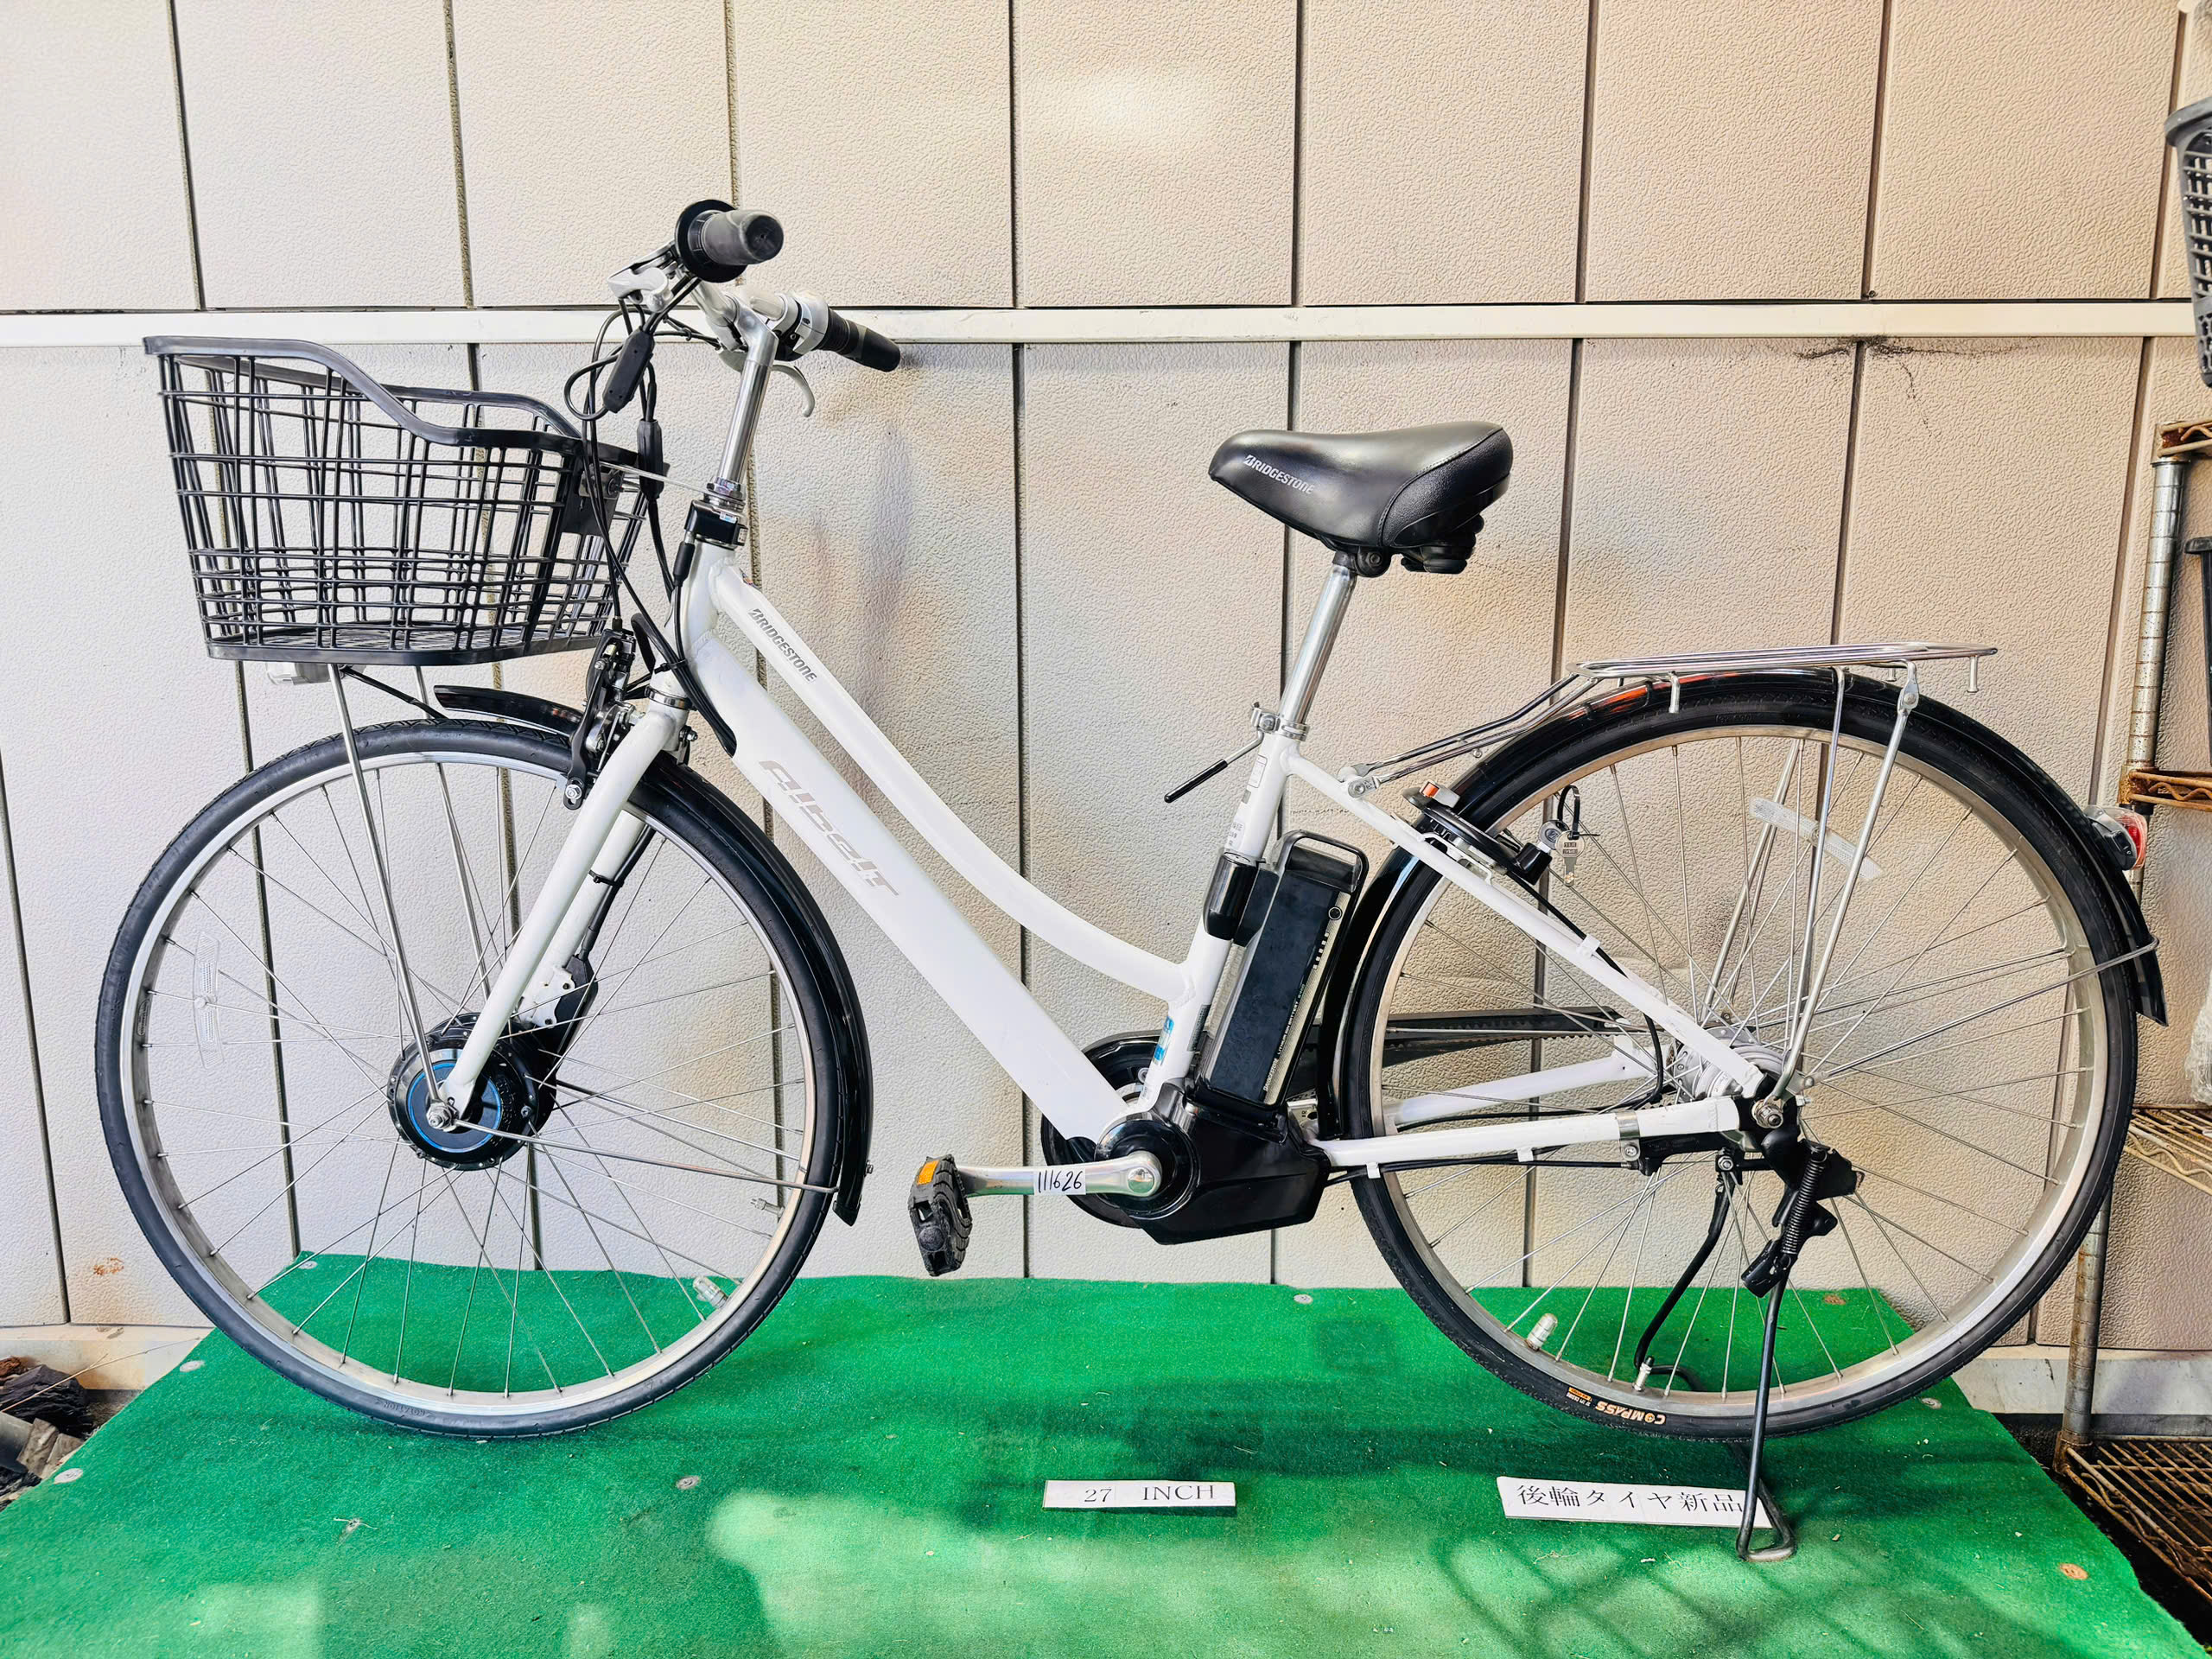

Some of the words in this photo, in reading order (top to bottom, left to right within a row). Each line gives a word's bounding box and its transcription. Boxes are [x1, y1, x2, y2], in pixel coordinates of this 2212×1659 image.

[1243, 454, 1316, 495] BRIDGESTONE
[747, 608, 817, 683] BRIDGESTONE
[1037, 1169, 1083, 1192] 111626
[1595, 1400, 1667, 1425] COMPASS
[1084, 1487, 1113, 1503] 27
[1142, 1484, 1215, 1501] INCH
[1517, 1484, 1744, 1514] 後輪タイヤ新品
